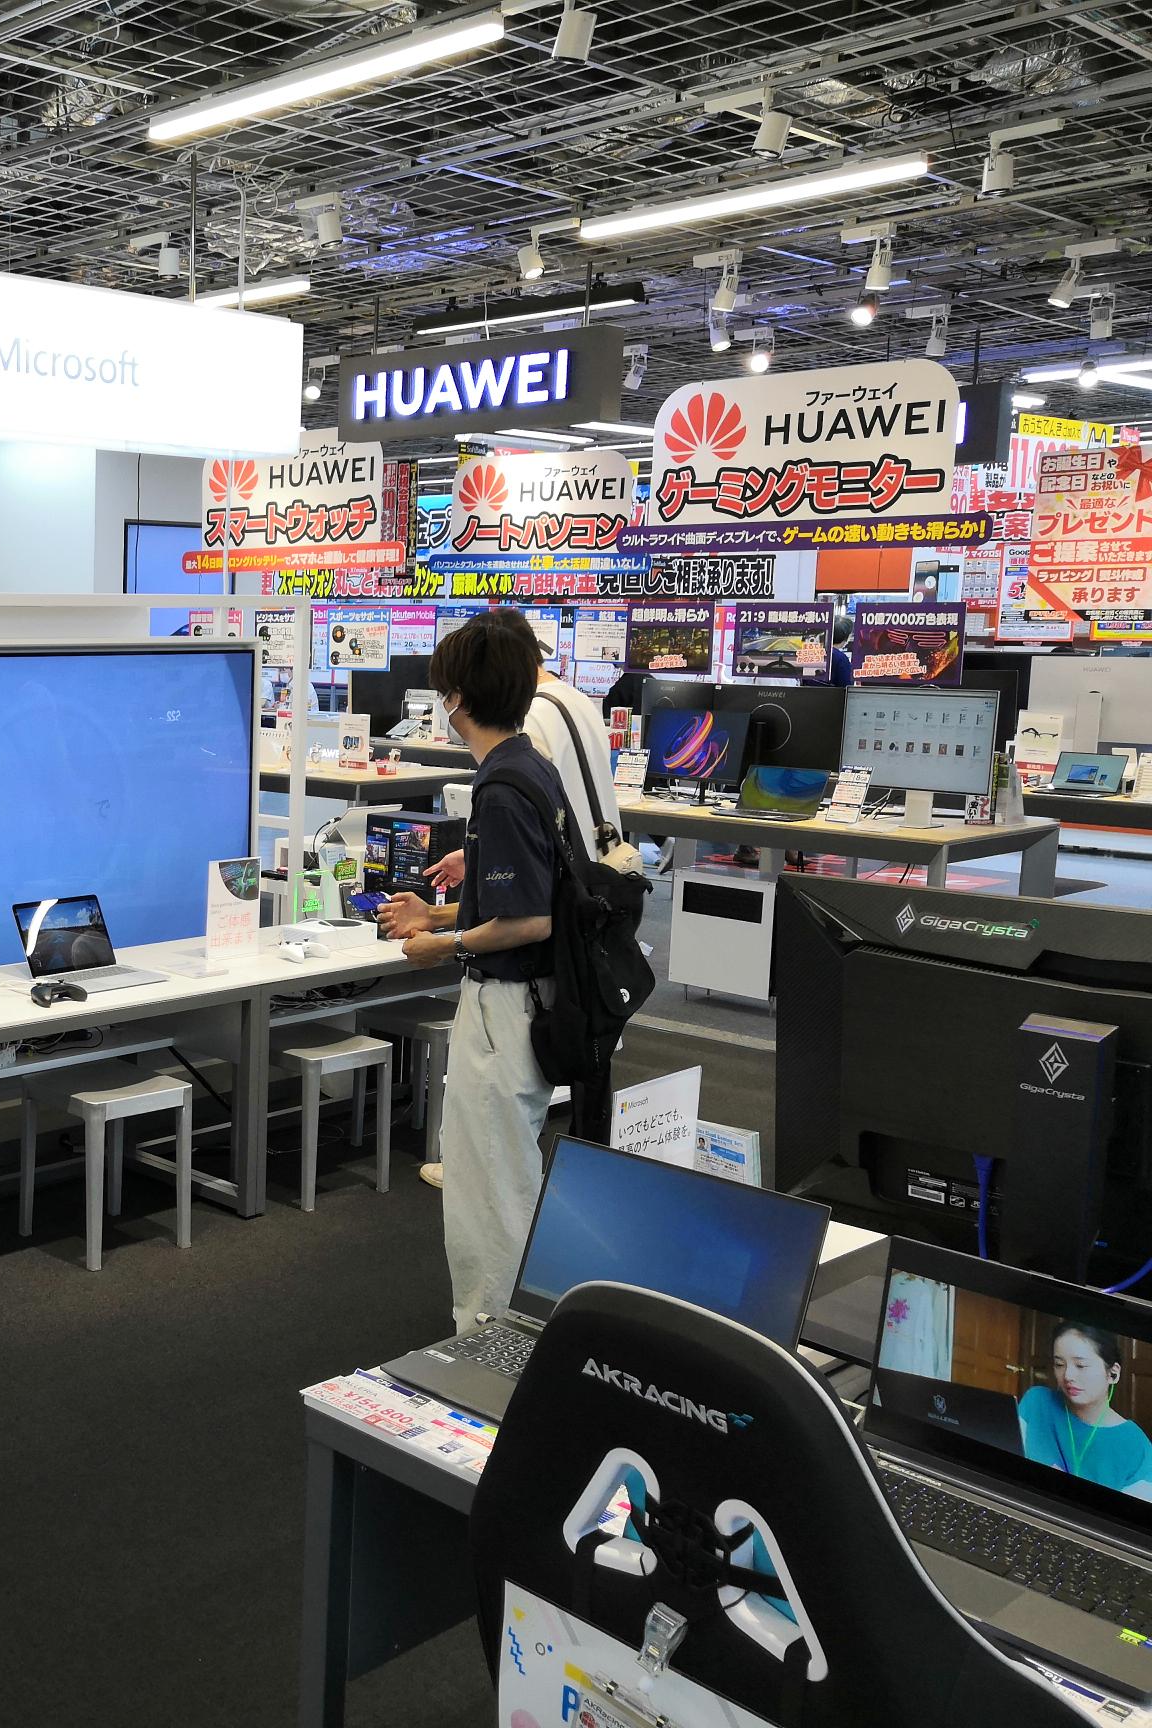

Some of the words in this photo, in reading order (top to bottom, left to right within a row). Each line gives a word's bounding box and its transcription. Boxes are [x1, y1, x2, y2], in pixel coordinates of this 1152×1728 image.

[354, 348, 570, 421] HUAWEI
[804, 382, 897, 407] ファーウェイ
[763, 399, 946, 447] HUAWEI
[269, 456, 375, 488] HUAWEI
[543, 464, 598, 477] ファーウェイ
[1042, 453, 1102, 472] お誕生日
[1107, 459, 1117, 468] や
[519, 477, 626, 502] HUAWEI
[659, 453, 945, 522] ゲーミングモニター
[1040, 474, 1086, 493] 記念日
[1091, 472, 1115, 480] などの
[1090, 480, 1131, 491] お祝いに
[1079, 498, 1116, 509] 最適な
[204, 494, 377, 546] スマートウォッチ
[1038, 509, 1152, 537] プレゼント
[452, 511, 629, 551] ノートパソコン
[1033, 541, 1098, 564] ご提案
[1100, 541, 1133, 551] させて
[1037, 569, 1093, 582] ラッピング
[1072, 586, 1141, 604] 承ります
[329, 611, 390, 622] スポーツをサポート!
[391, 609, 415, 621] akuten
[415, 610, 436, 620] Mobile
[739, 611, 766, 623] 21:9
[757, 690, 786, 698] HUAWEI
[485, 870, 517, 881] since
[920, 913, 1029, 939] GigaCrysta
[1019, 1082, 1086, 1102] GigaCrysta
[627, 1096, 649, 1110] Microsoft
[375, 1378, 393, 1388] CPU
[581, 1358, 730, 1434] AKRACING
